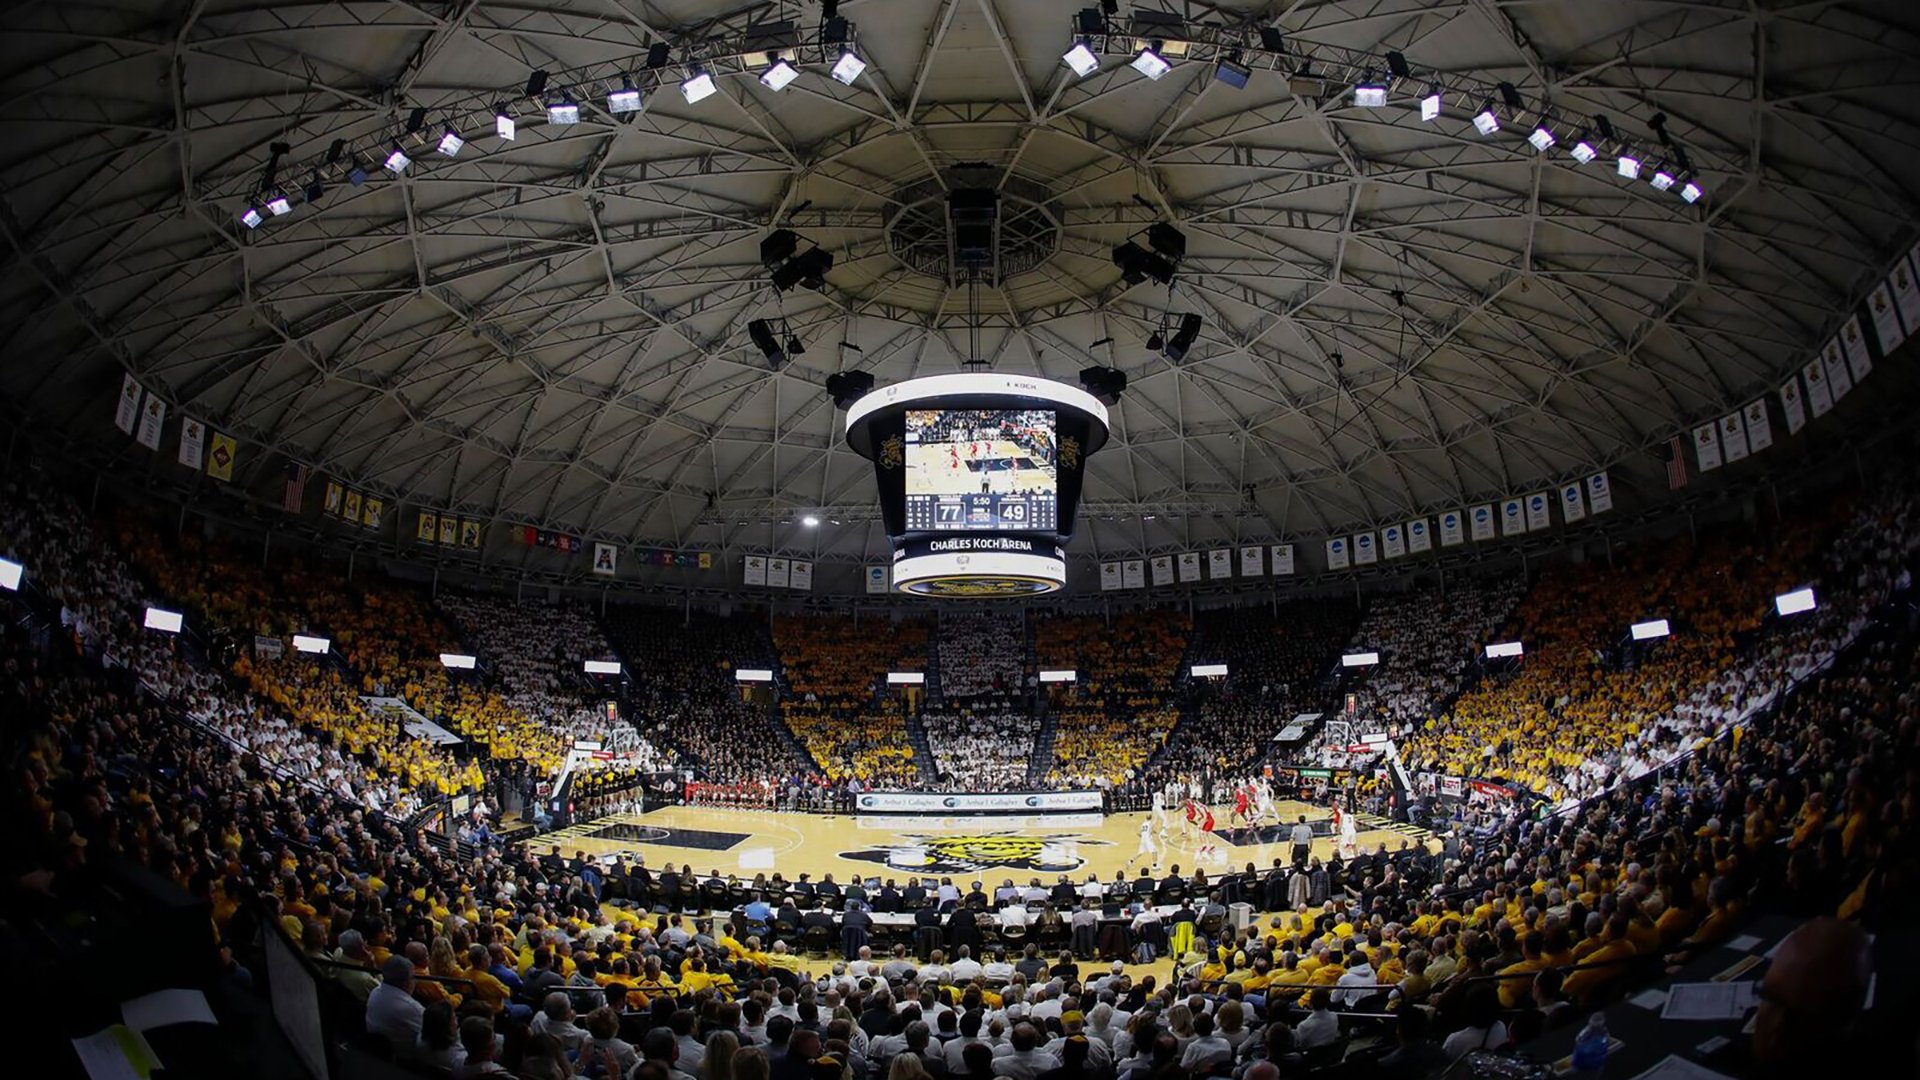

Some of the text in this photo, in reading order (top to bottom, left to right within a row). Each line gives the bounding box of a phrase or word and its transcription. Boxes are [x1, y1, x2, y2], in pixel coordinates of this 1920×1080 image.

[940, 505, 961, 521] 77
[1003, 505, 1025, 521] 49
[930, 537, 1032, 552] CHARLES KOCH ARENA
